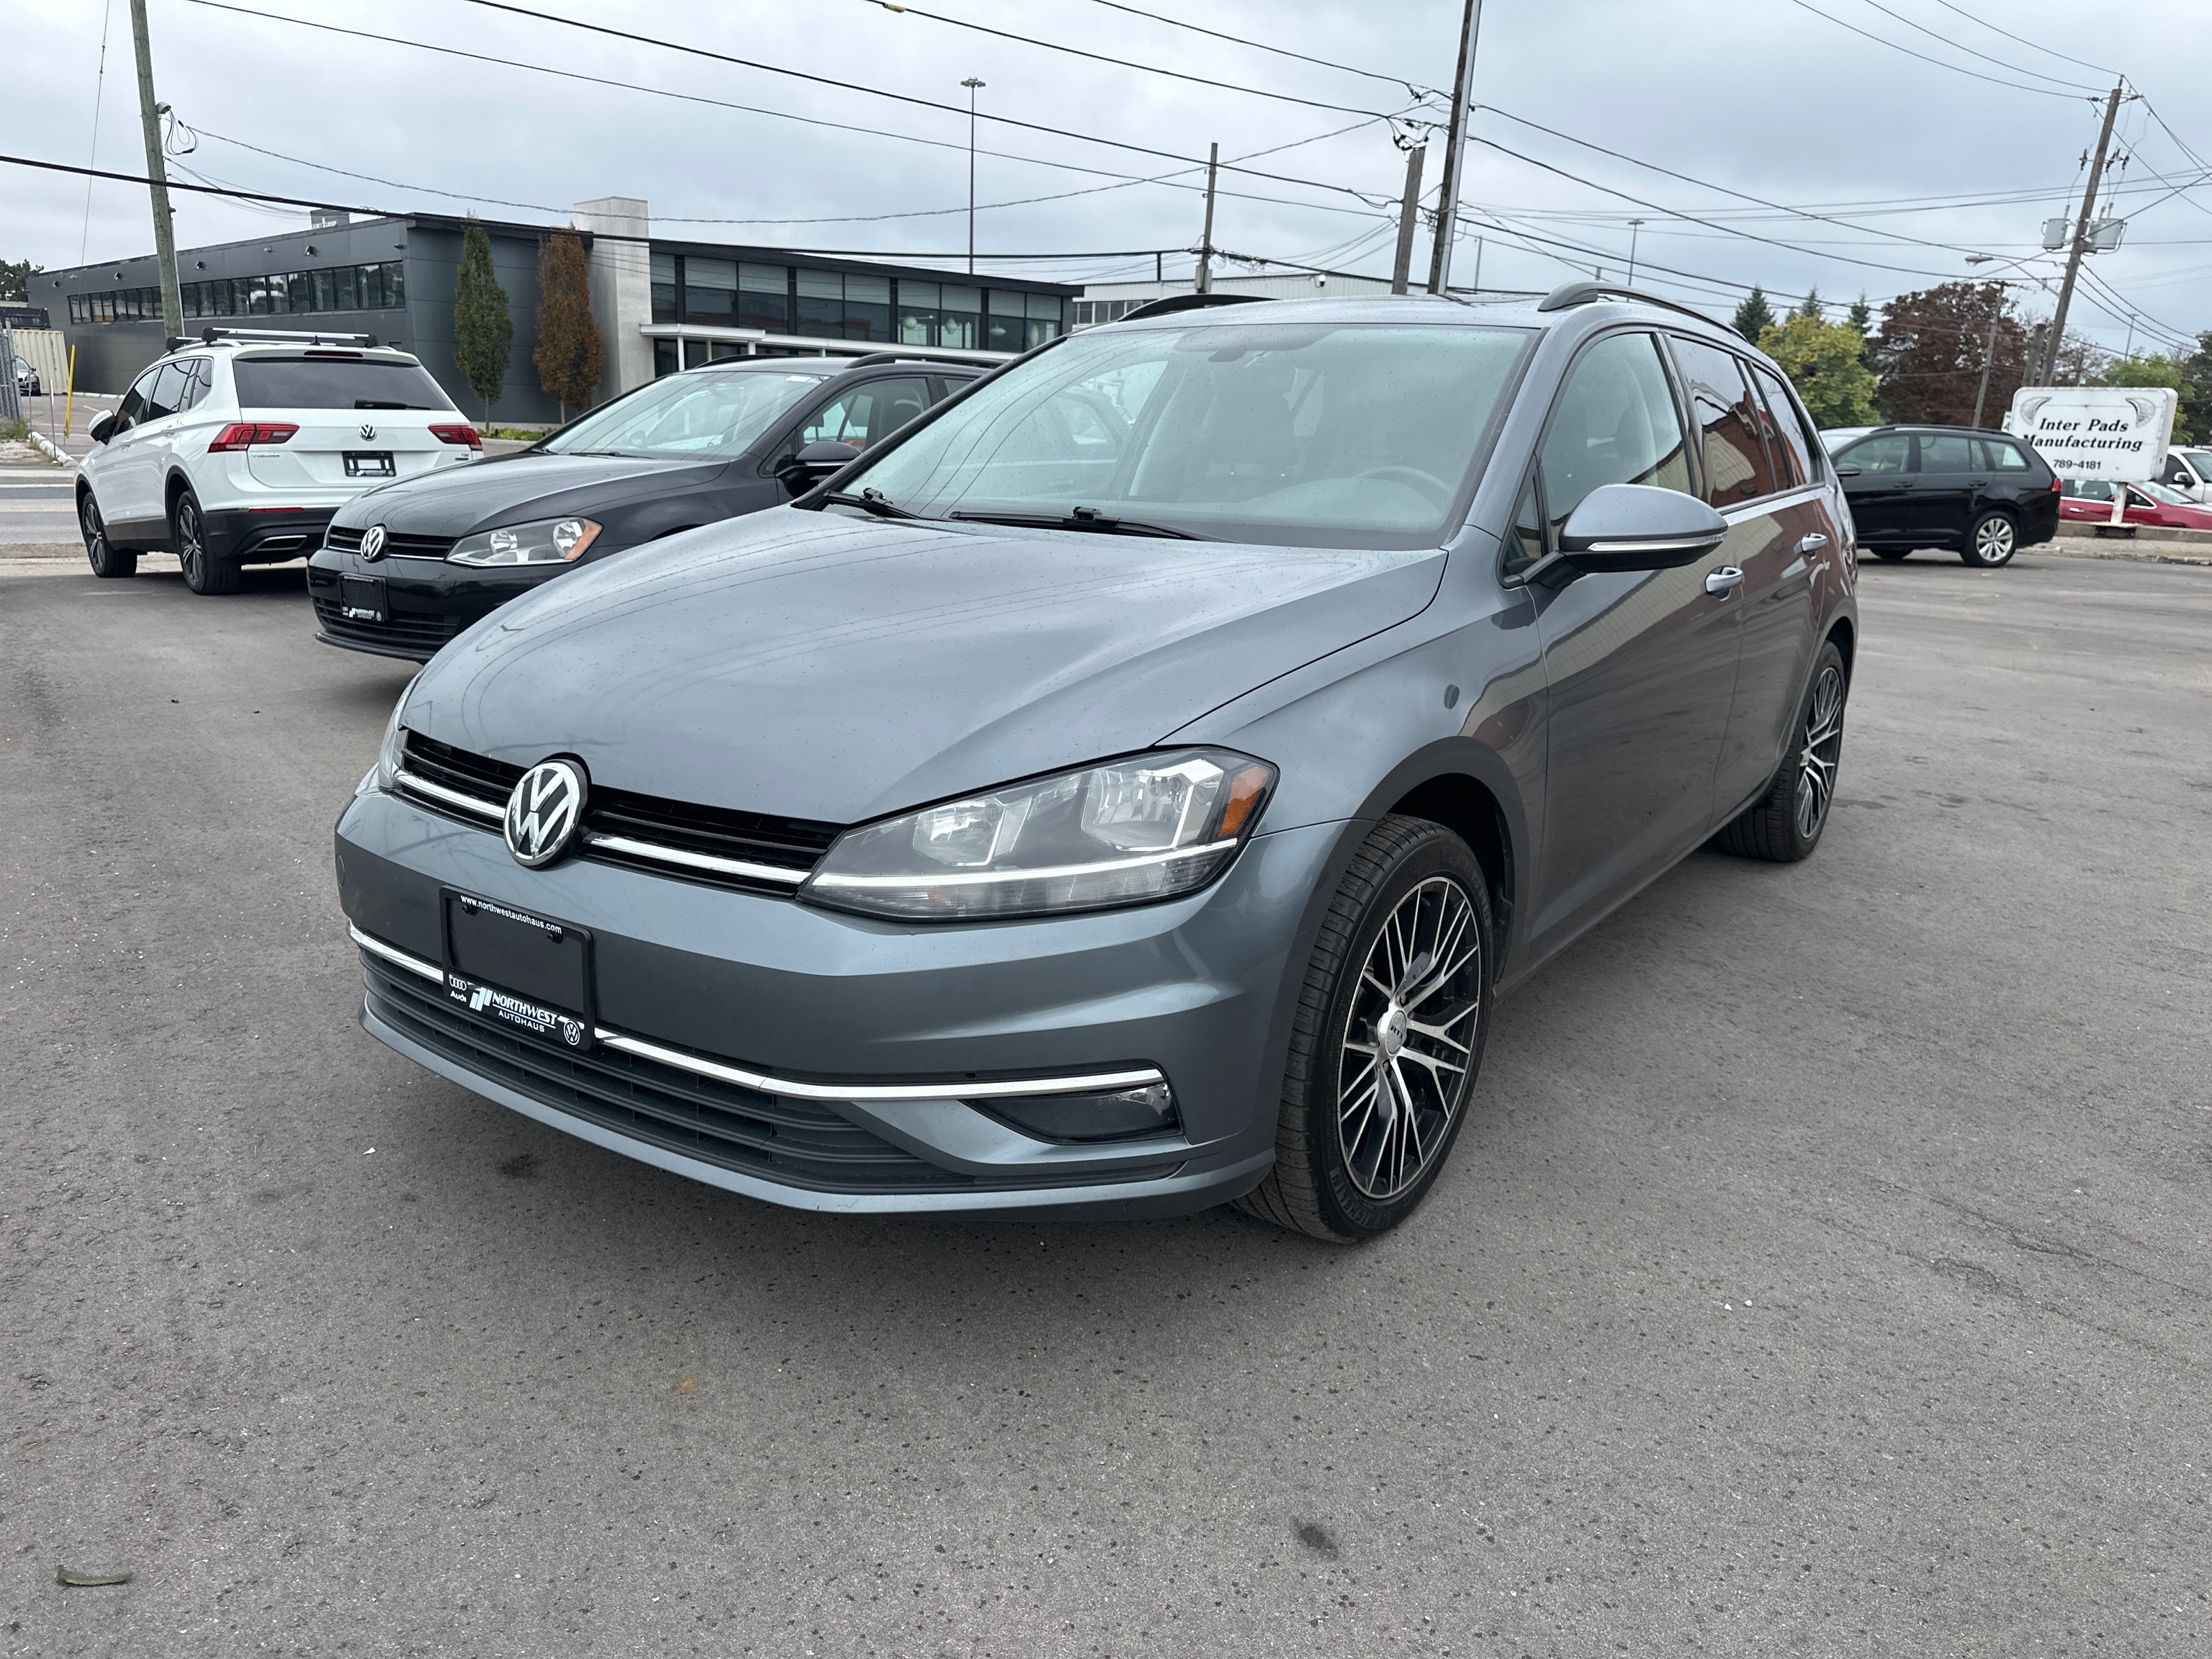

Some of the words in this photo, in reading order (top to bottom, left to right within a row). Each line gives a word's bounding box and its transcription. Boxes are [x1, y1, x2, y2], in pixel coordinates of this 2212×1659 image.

[2038, 418, 2080, 431] Inter
[2087, 418, 2129, 432] Pads
[2023, 434, 2144, 452] Manufacturing
[2053, 459, 2101, 469] 789-4181
[460, 894, 562, 935] www.northwestautohaus.com
[492, 992, 558, 1025] NORTHWEST
[498, 1010, 545, 1033] AUTOHAUS
